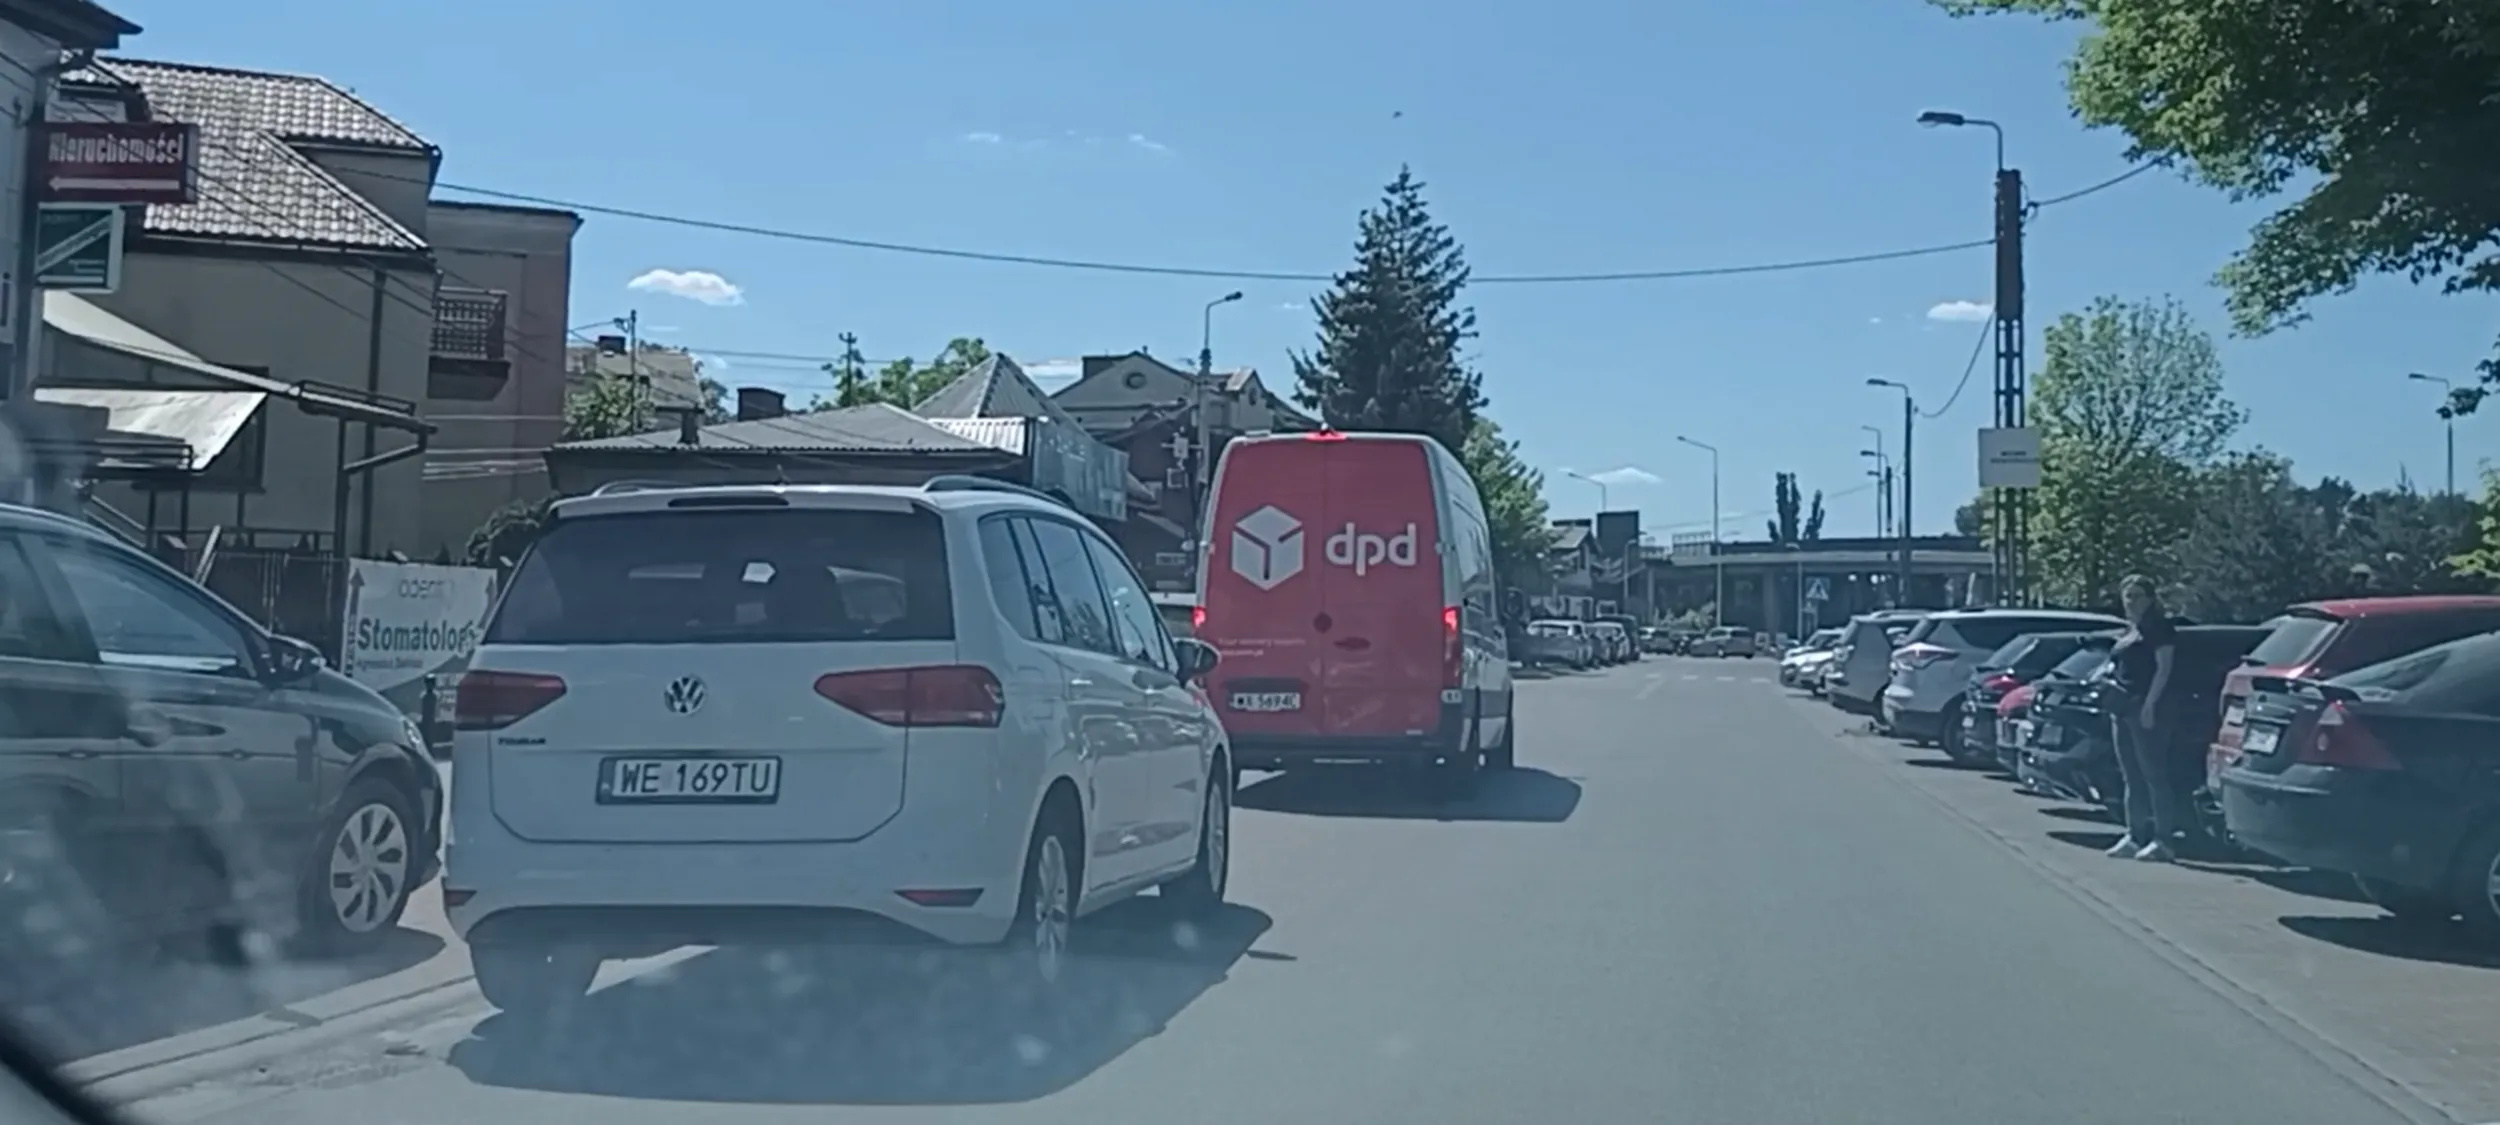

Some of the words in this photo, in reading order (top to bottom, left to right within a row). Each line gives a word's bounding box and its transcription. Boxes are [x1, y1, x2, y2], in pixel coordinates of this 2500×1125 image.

[48, 132, 184, 163] Nieruchomości
[1325, 522, 1416, 576] dpd
[620, 762, 661, 793] WE
[676, 762, 771, 793] 169TU
